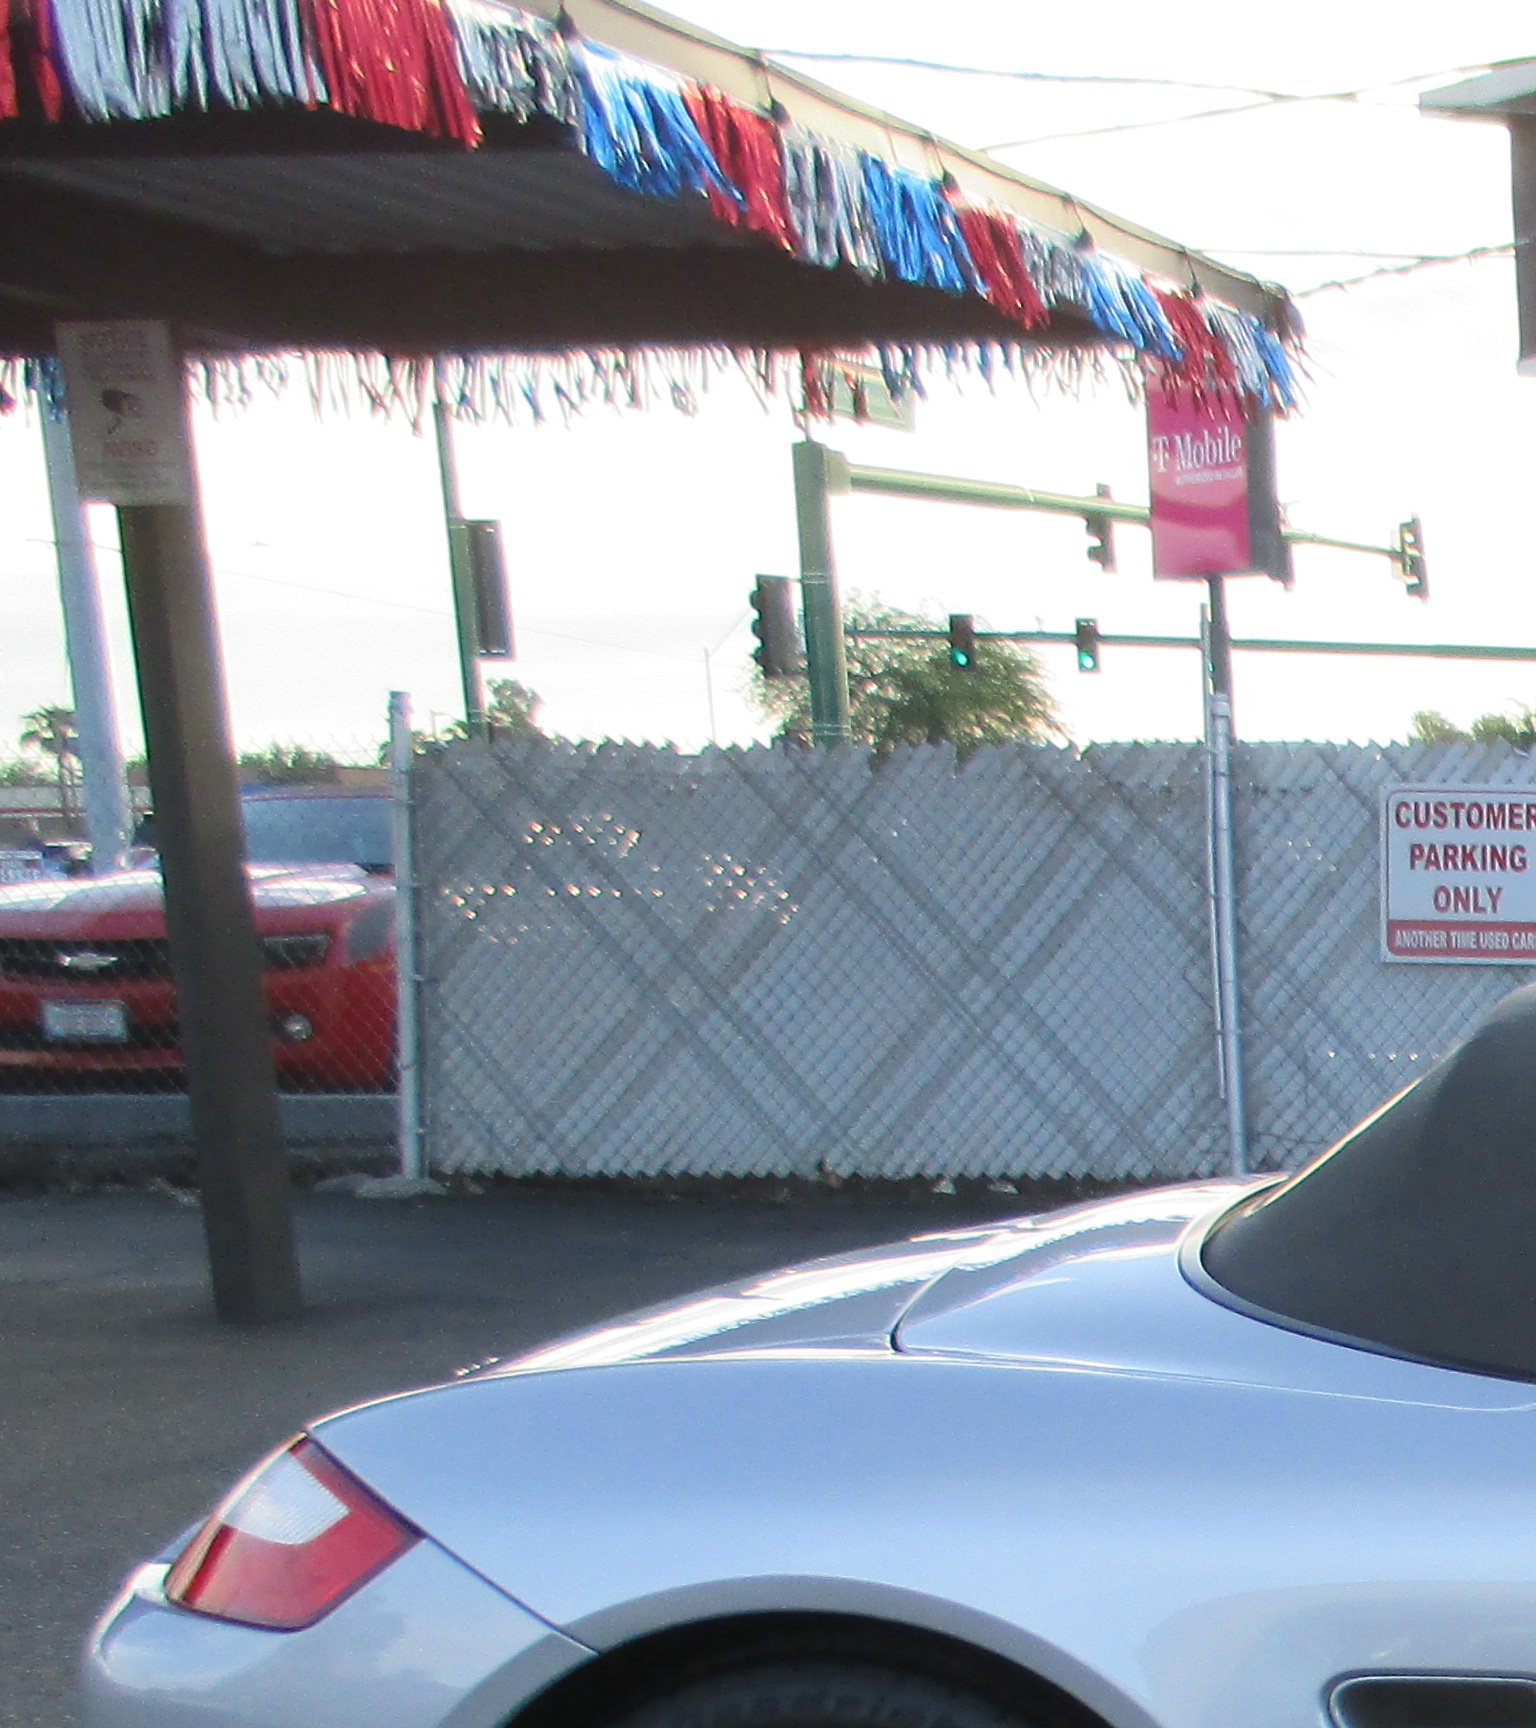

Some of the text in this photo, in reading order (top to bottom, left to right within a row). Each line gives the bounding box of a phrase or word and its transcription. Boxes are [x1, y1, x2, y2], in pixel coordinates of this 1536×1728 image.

[1409, 843, 1527, 872] PARKING
[1433, 885, 1503, 914] ONLY
[1395, 930, 1448, 948] ANOTHER
[1450, 931, 1477, 949] TIME
[1479, 932, 1509, 950] USED
